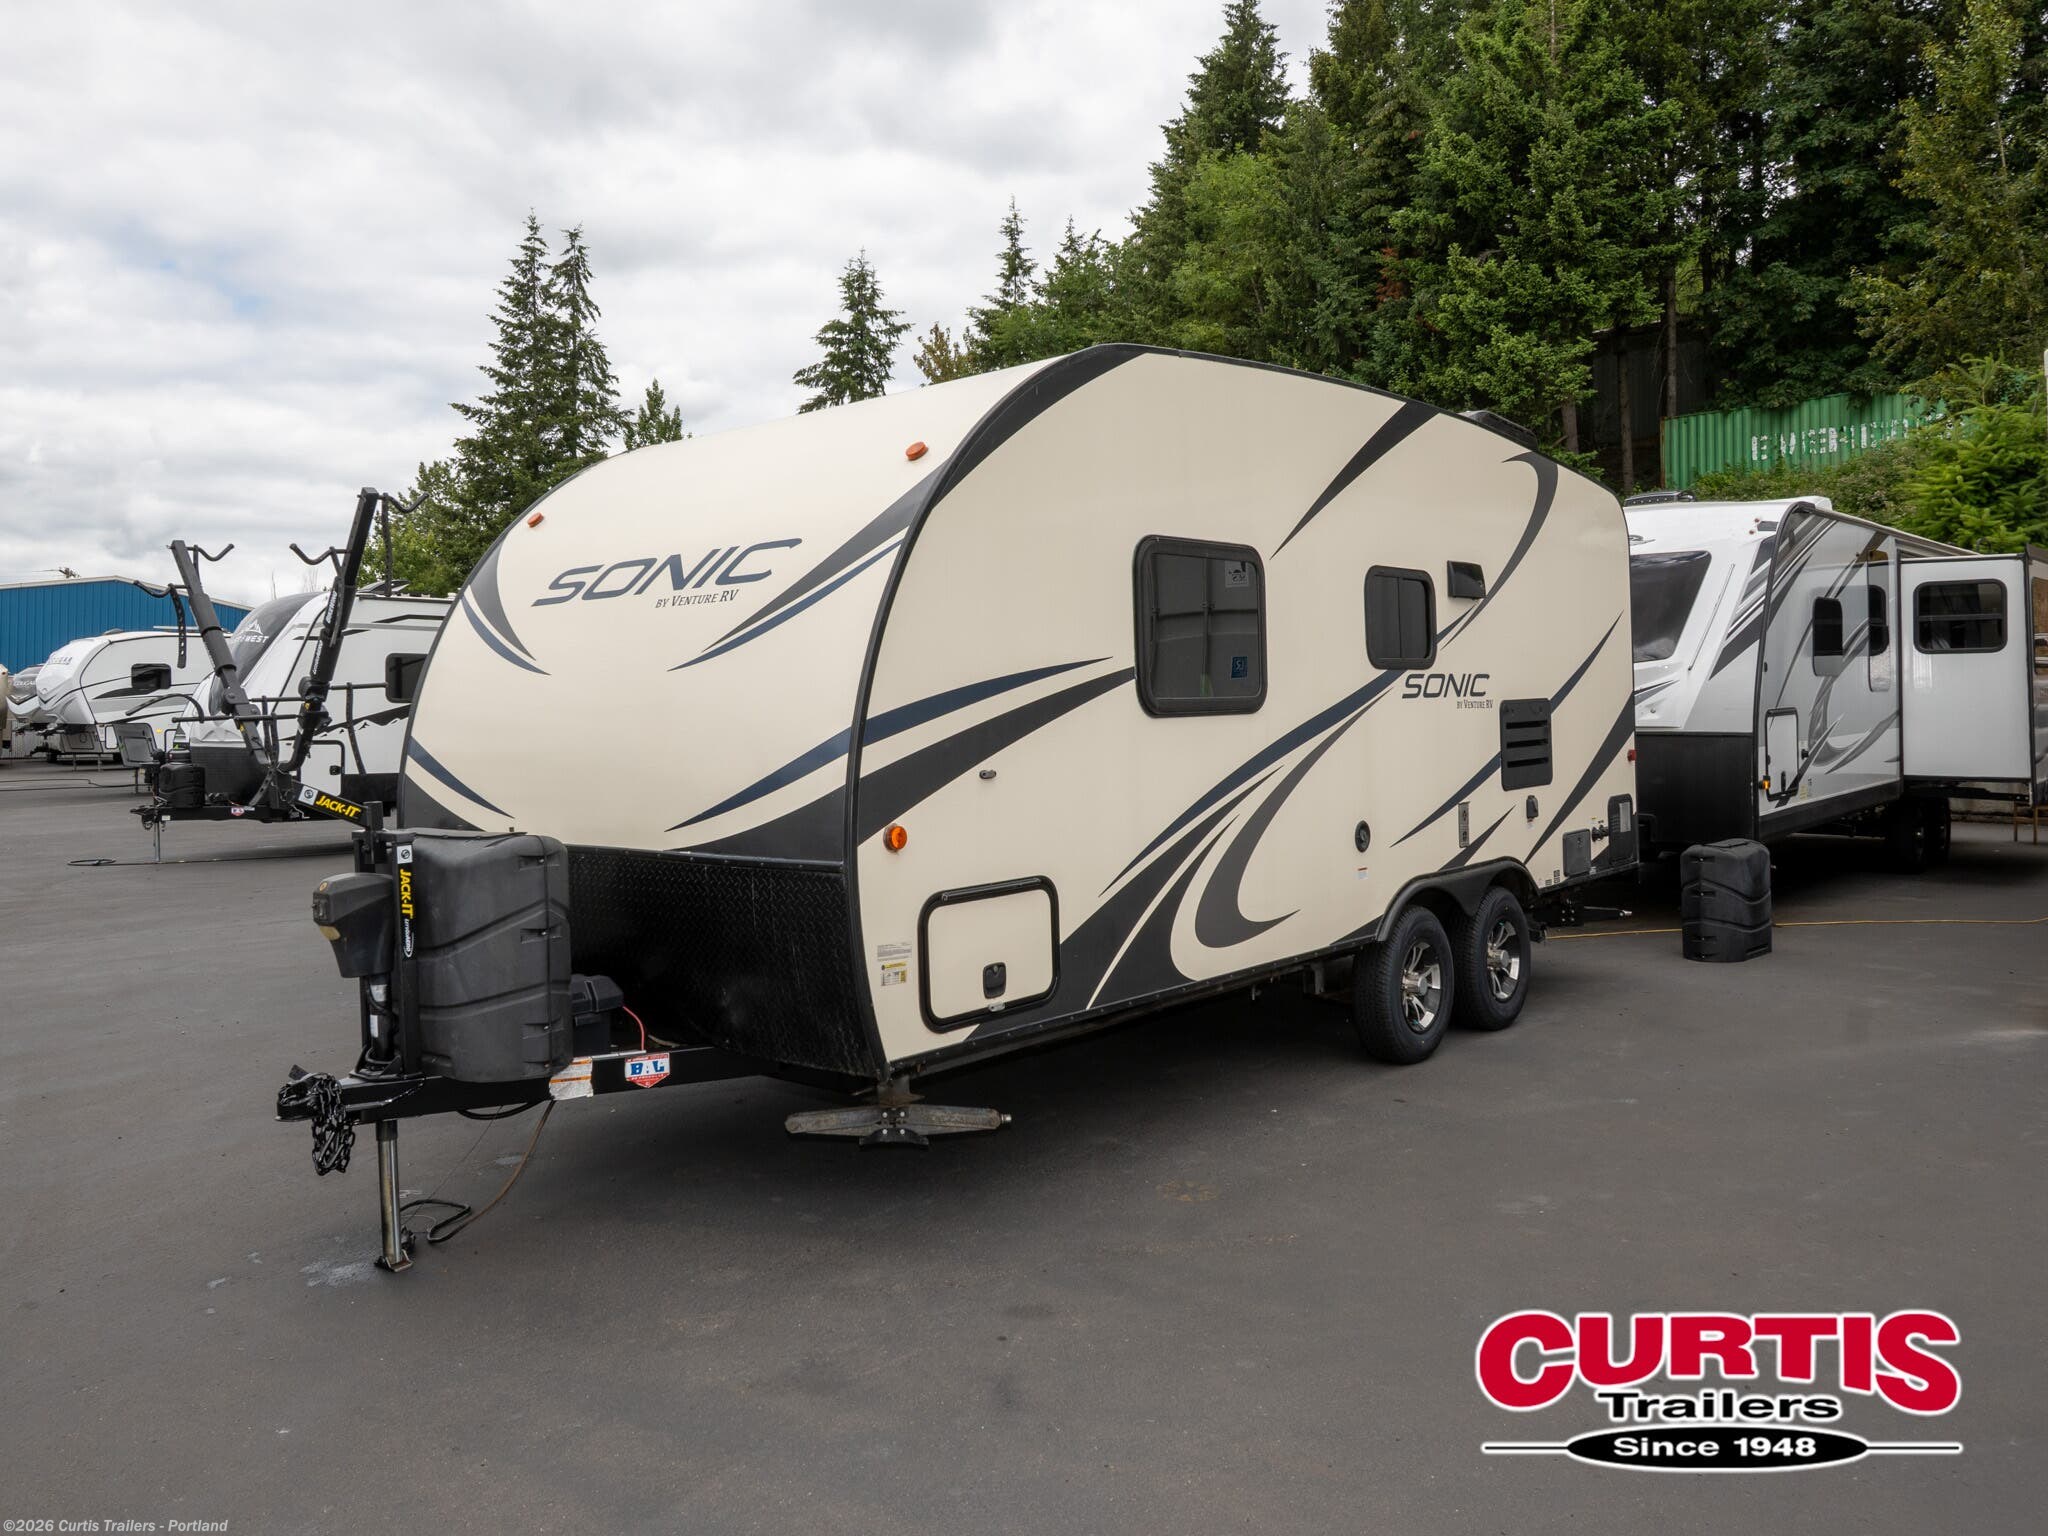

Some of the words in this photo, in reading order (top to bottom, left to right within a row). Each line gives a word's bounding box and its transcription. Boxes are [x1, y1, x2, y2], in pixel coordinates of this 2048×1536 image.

[531, 538, 802, 607] SONIC
[655, 598, 670, 608] BY
[671, 593, 719, 607] VENTURE
[720, 589, 739, 602] RV
[1402, 673, 1491, 699] SONIC
[316, 795, 361, 817] JACK-IT
[400, 869, 414, 918] JACK-IT
